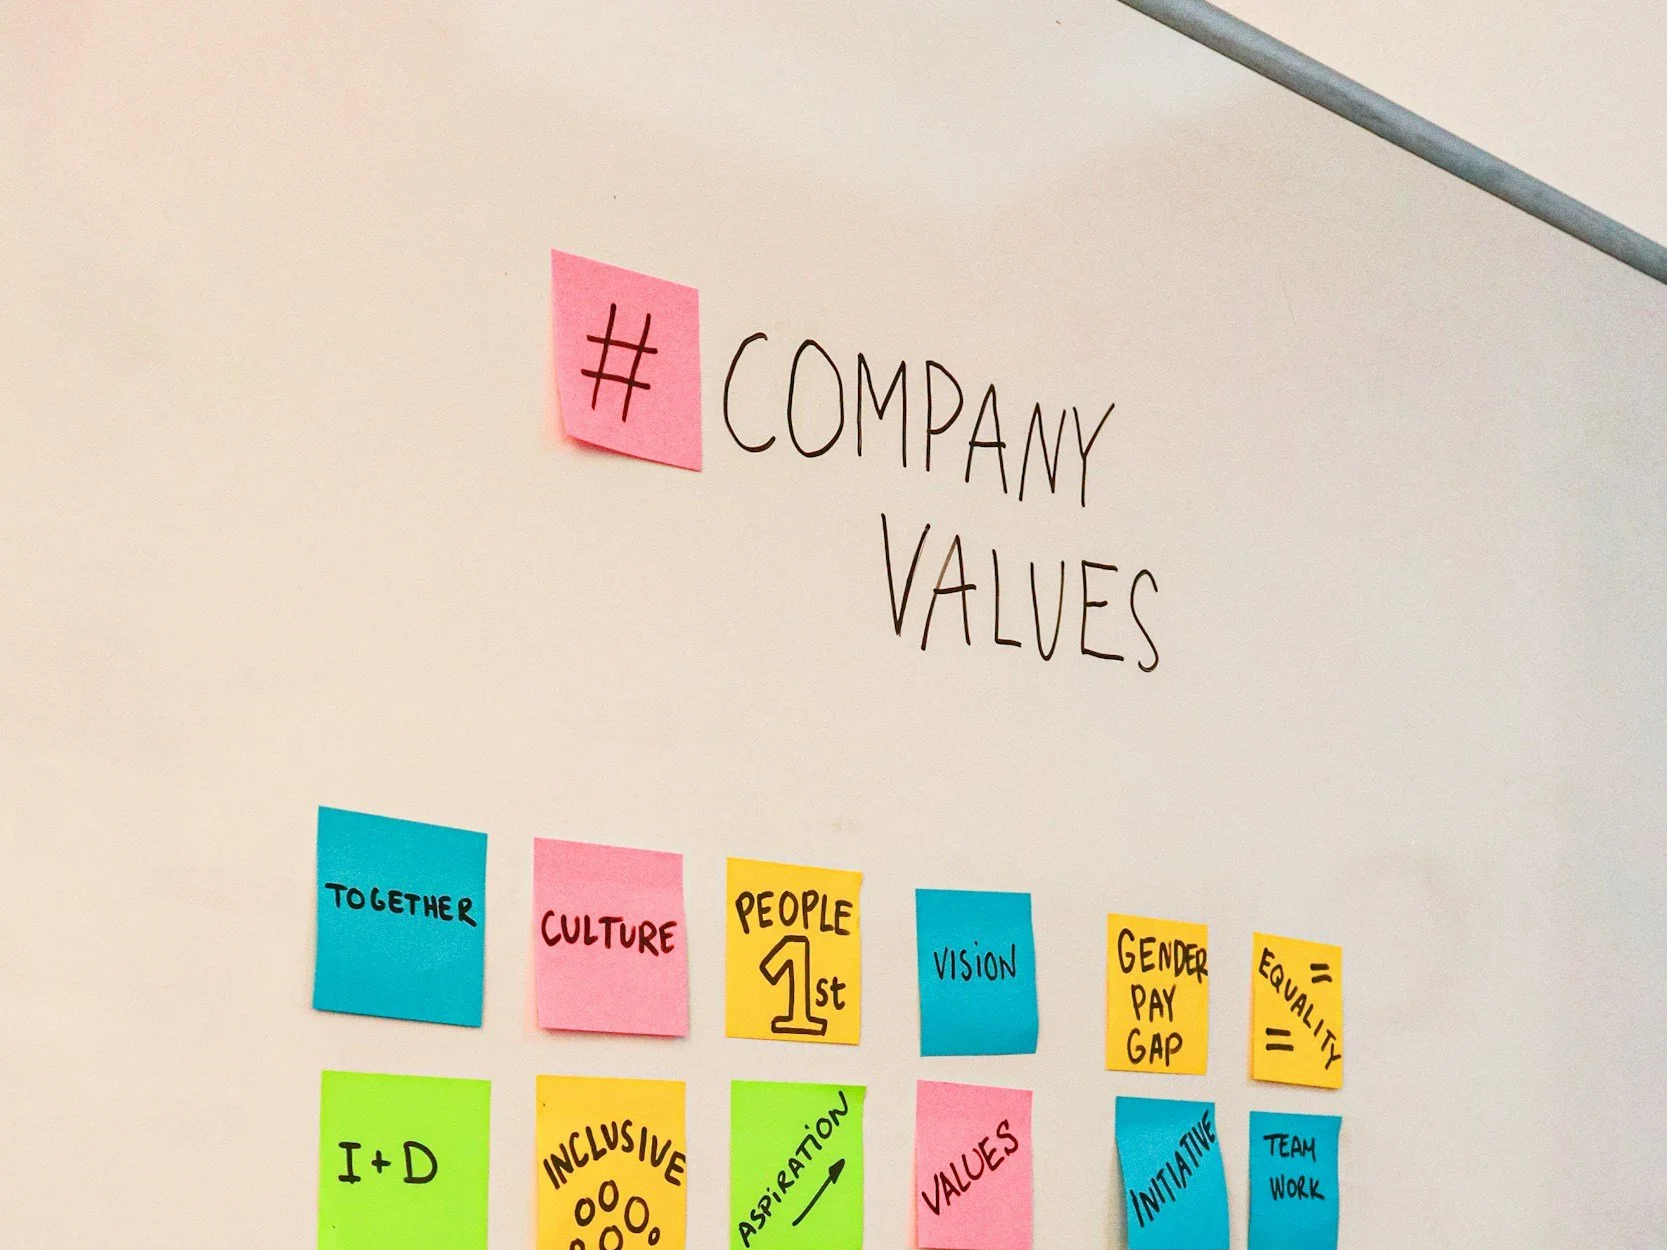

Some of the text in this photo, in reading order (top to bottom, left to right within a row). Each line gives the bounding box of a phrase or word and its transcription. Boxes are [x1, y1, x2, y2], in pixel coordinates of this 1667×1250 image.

[723, 332, 1114, 506] COMPANY
[880, 513, 1159, 672] VALUES
[325, 882, 477, 928] TOGETHER
[736, 890, 853, 935] PEOPLE
[541, 910, 677, 956] CULTURE
[1117, 928, 1208, 983] GENDER
[759, 935, 846, 1036] 1st
[1132, 985, 1176, 1022] PAY
[1259, 948, 1341, 1071] EQUALITY
[1127, 1028, 1183, 1067] GAP
[543, 1119, 686, 1190] INCLUSIVE
[922, 1120, 1019, 1216] VALUES
[1130, 1109, 1217, 1227] INITIATIVE
[1263, 1133, 1317, 1160] TEAM
[1270, 1175, 1325, 1201] WORK
